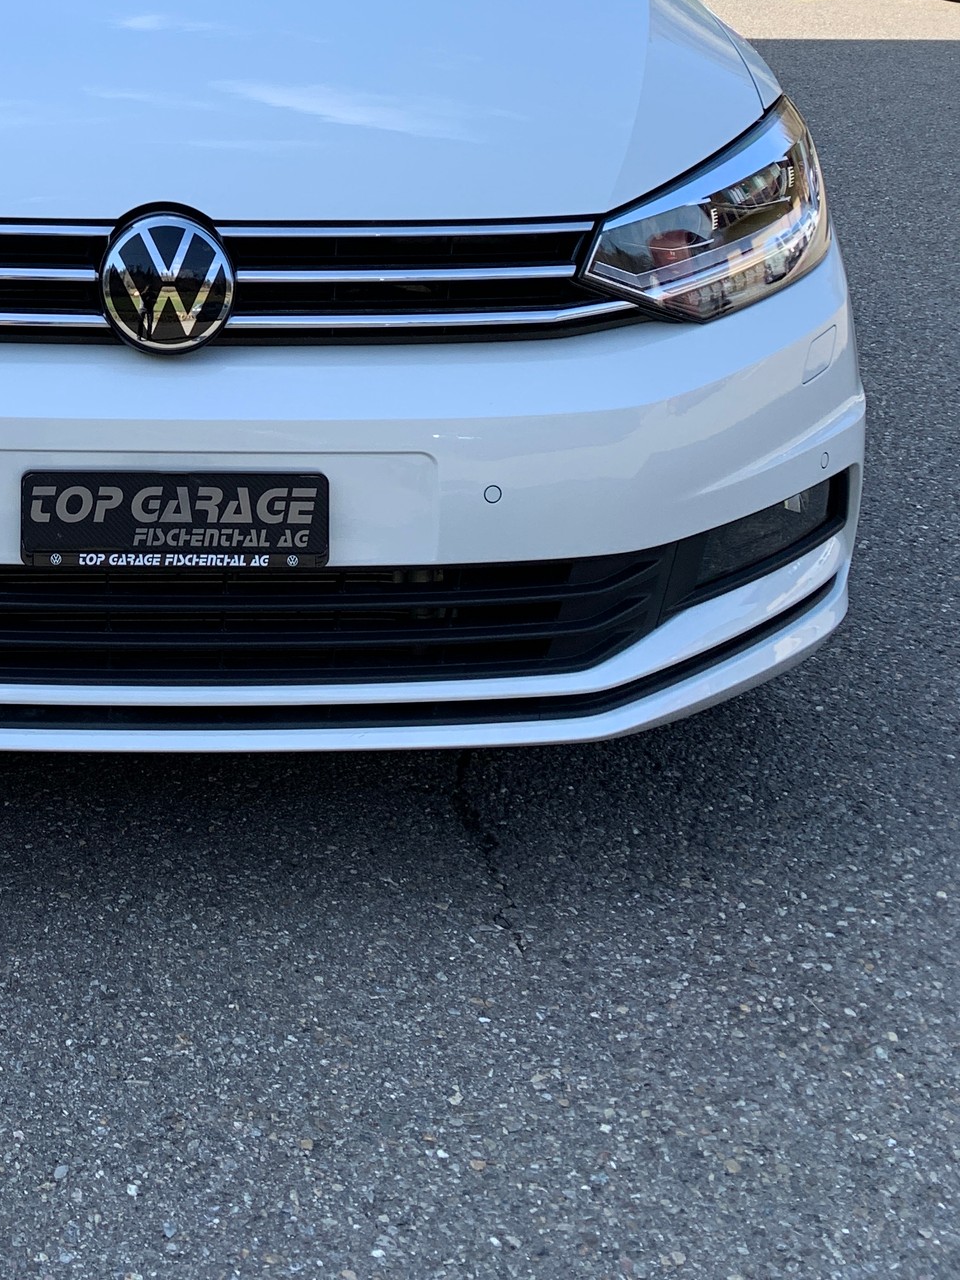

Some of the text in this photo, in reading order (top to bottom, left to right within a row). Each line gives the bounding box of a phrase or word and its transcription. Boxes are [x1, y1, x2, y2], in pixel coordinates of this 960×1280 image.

[30, 486, 318, 524] TOP GARAGE
[133, 528, 310, 548] FISCHENTHAL AG
[78, 553, 104, 565] TOP
[109, 553, 161, 566] GARAGE
[165, 553, 247, 566] FISCHENTHAL
[250, 554, 270, 567] AG
